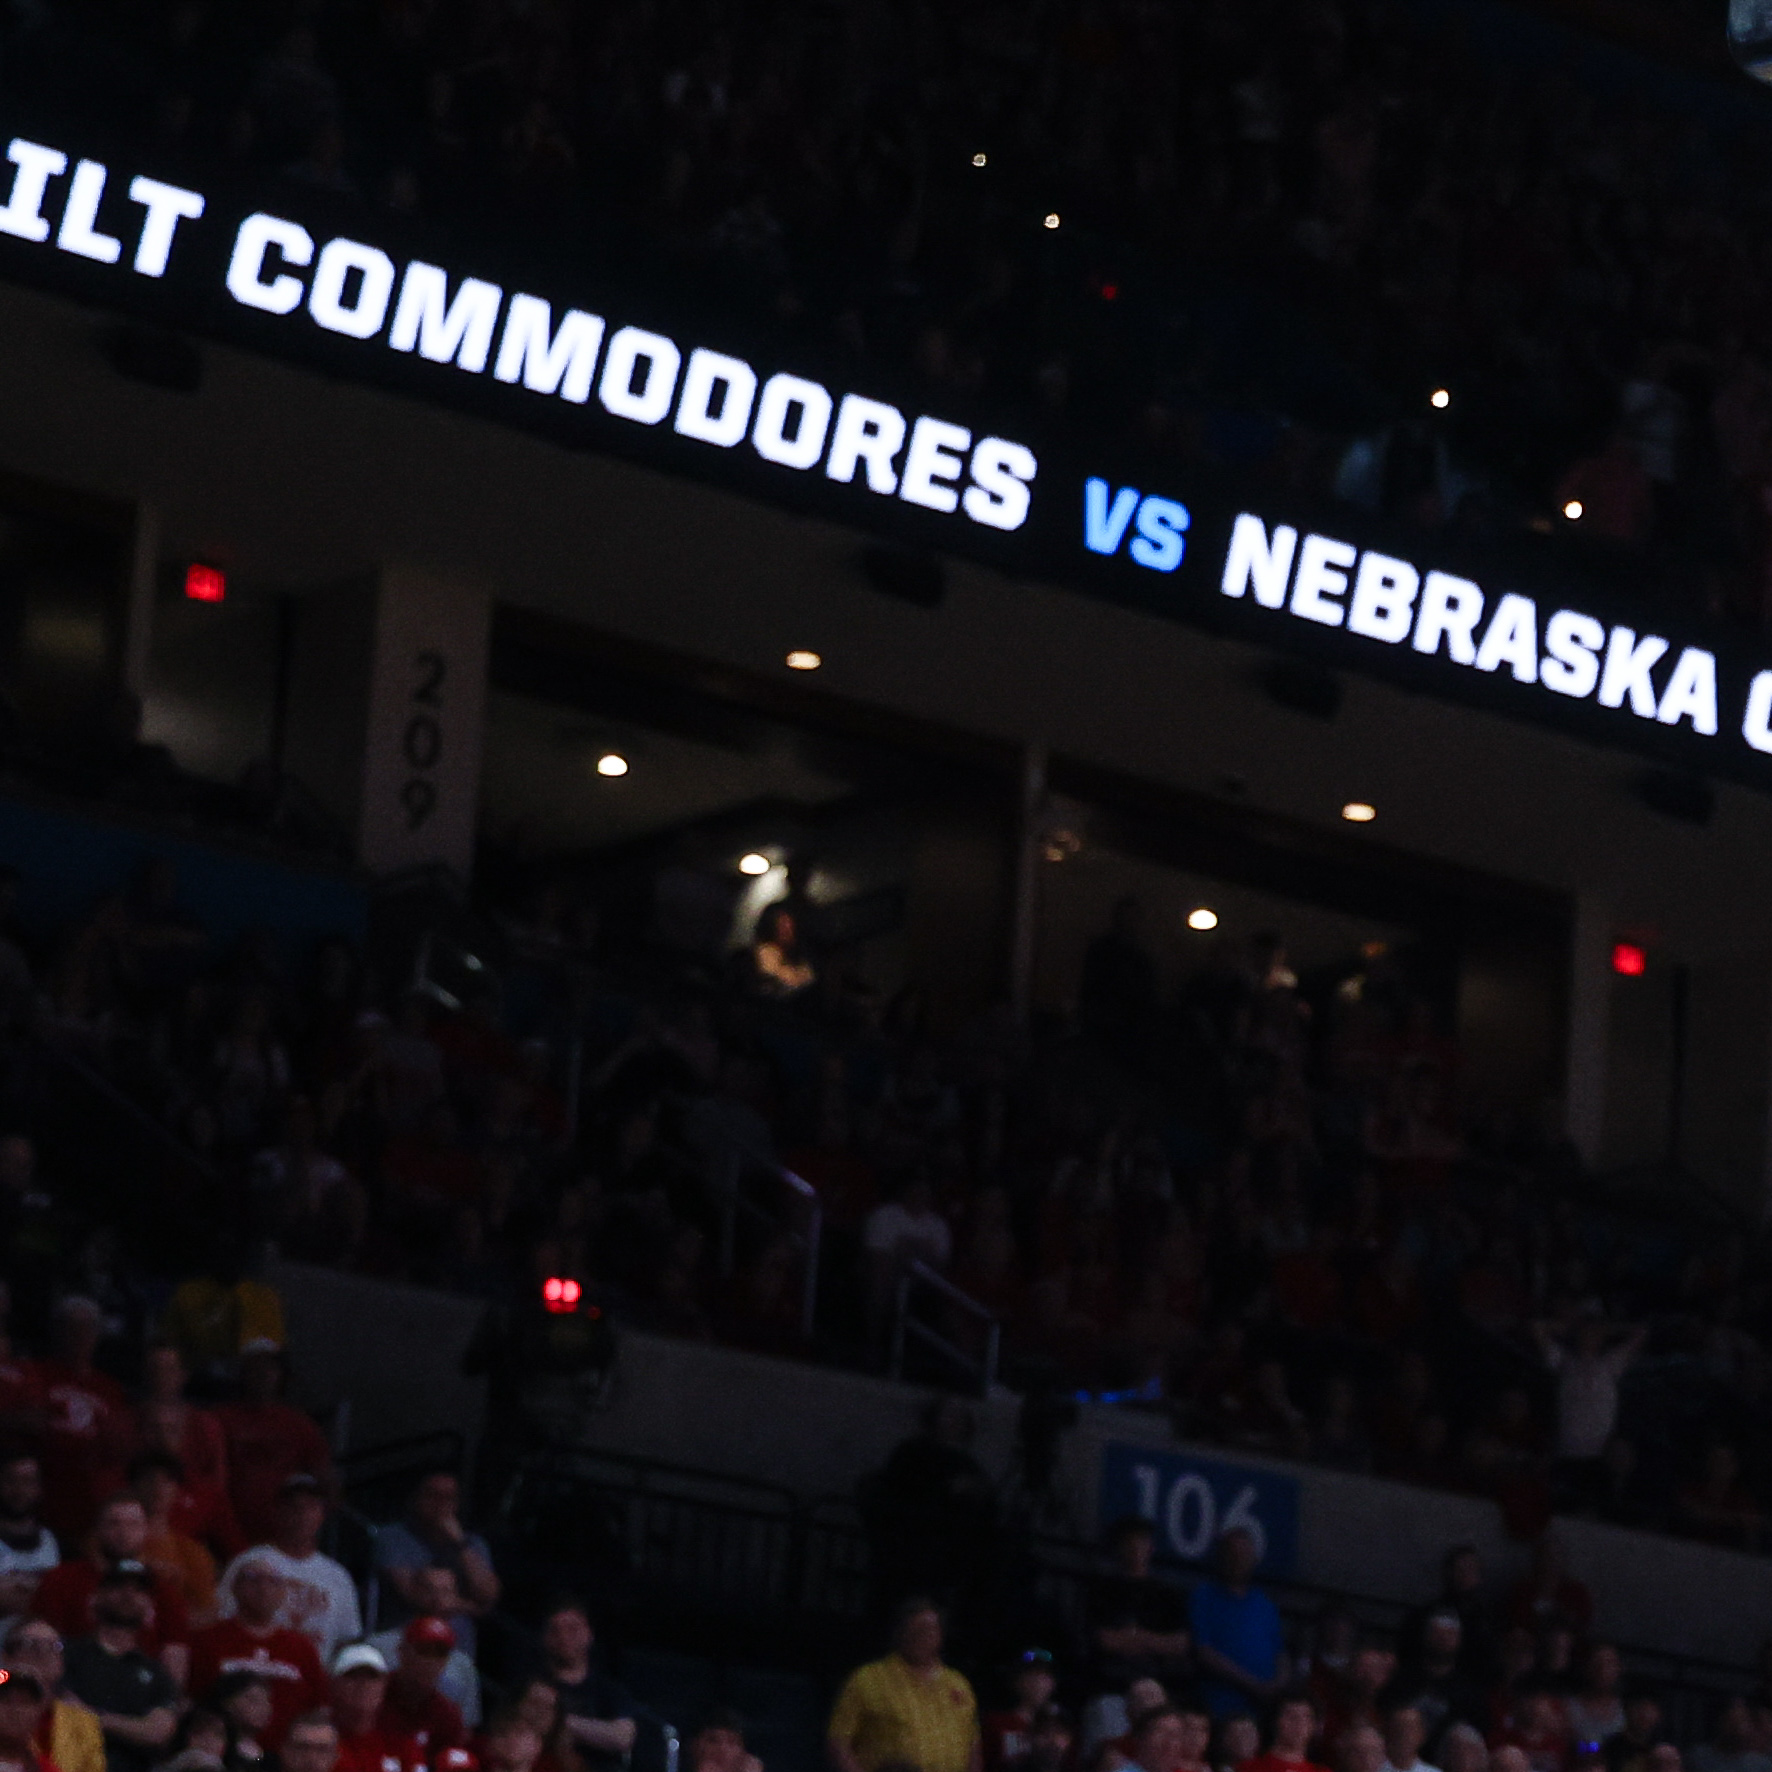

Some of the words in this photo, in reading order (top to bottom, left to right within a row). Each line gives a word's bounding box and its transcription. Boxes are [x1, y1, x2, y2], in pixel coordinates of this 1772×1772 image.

[226, 212, 1037, 531] COMMODORES
[1084, 478, 1190, 573] VS
[1220, 514, 1717, 736] NEBRASKA
